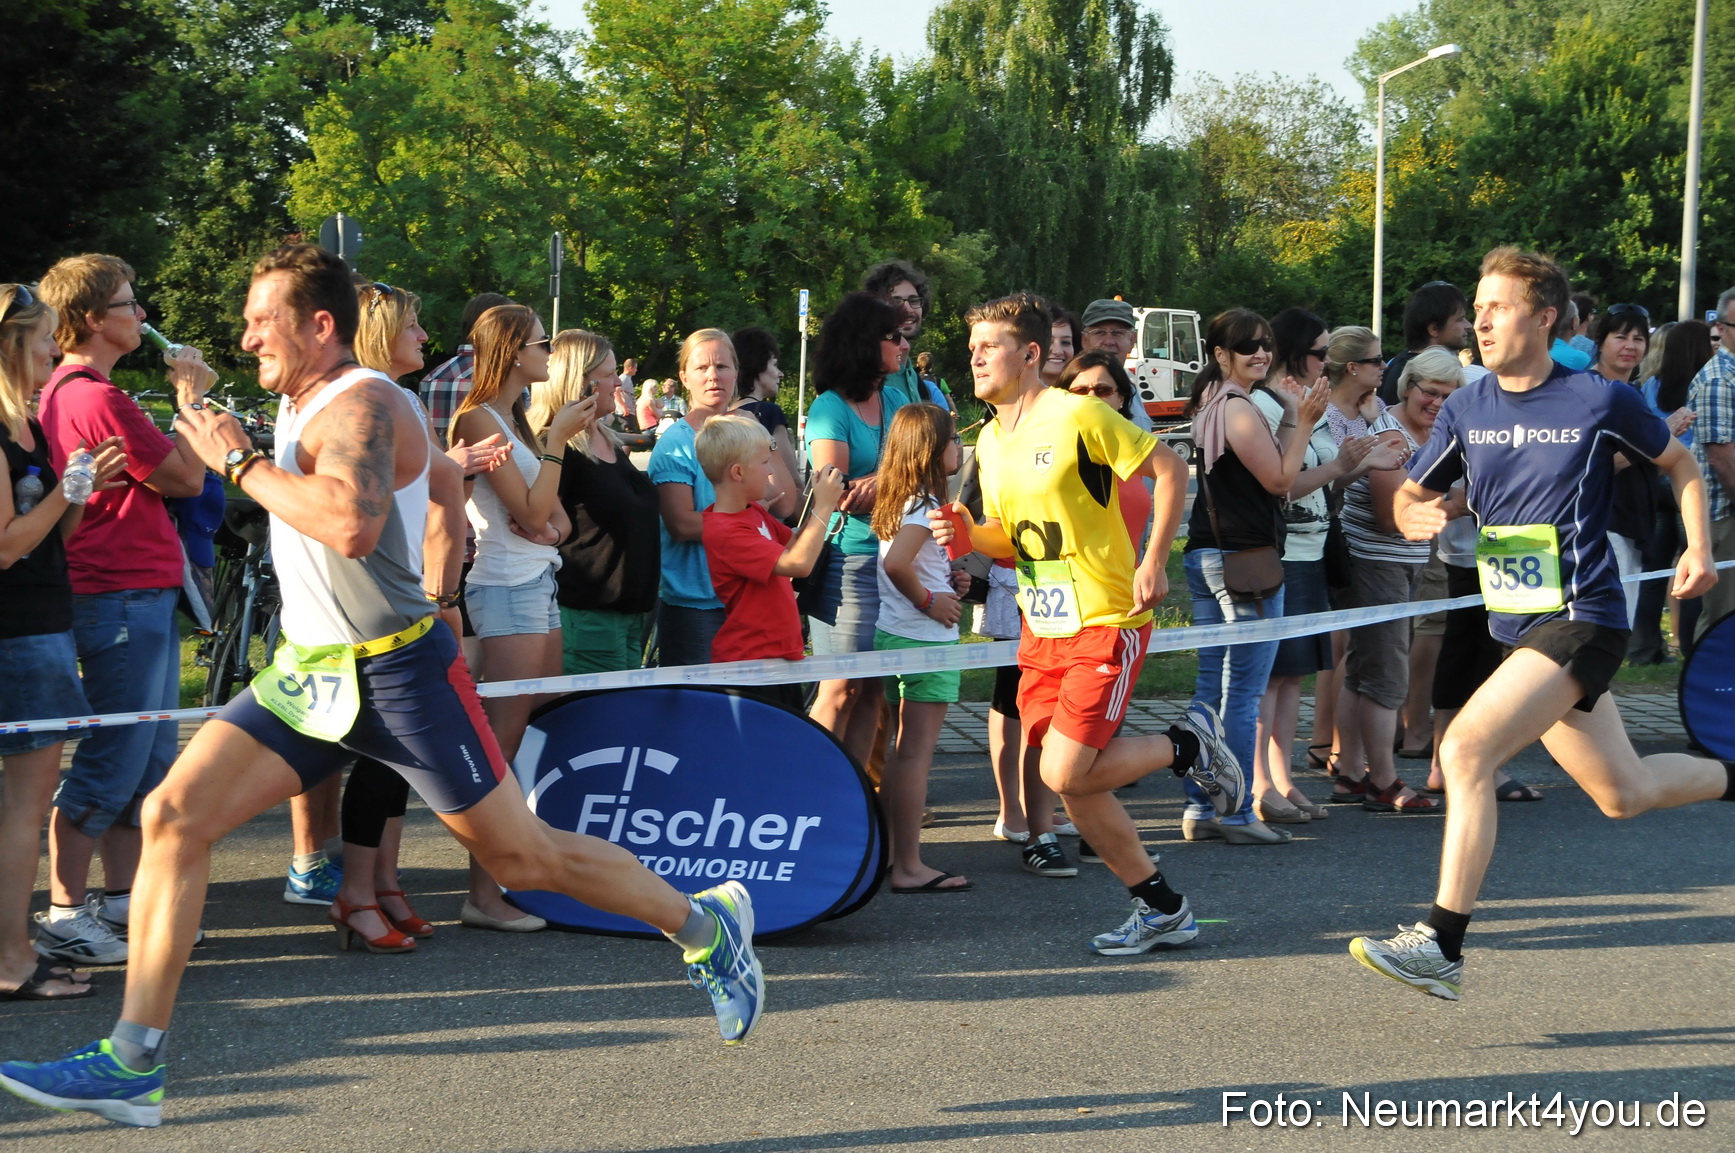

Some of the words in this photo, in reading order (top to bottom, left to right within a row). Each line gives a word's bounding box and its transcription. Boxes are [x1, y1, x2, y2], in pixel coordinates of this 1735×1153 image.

[1468, 429, 1511, 445] EURO
[1527, 428, 1581, 443] POLES
[1035, 451, 1051, 466] FC
[1487, 555, 1543, 591] 358
[1026, 587, 1069, 619] 232
[576, 794, 821, 851] Fischer
[632, 855, 796, 882] TOMOBILE
